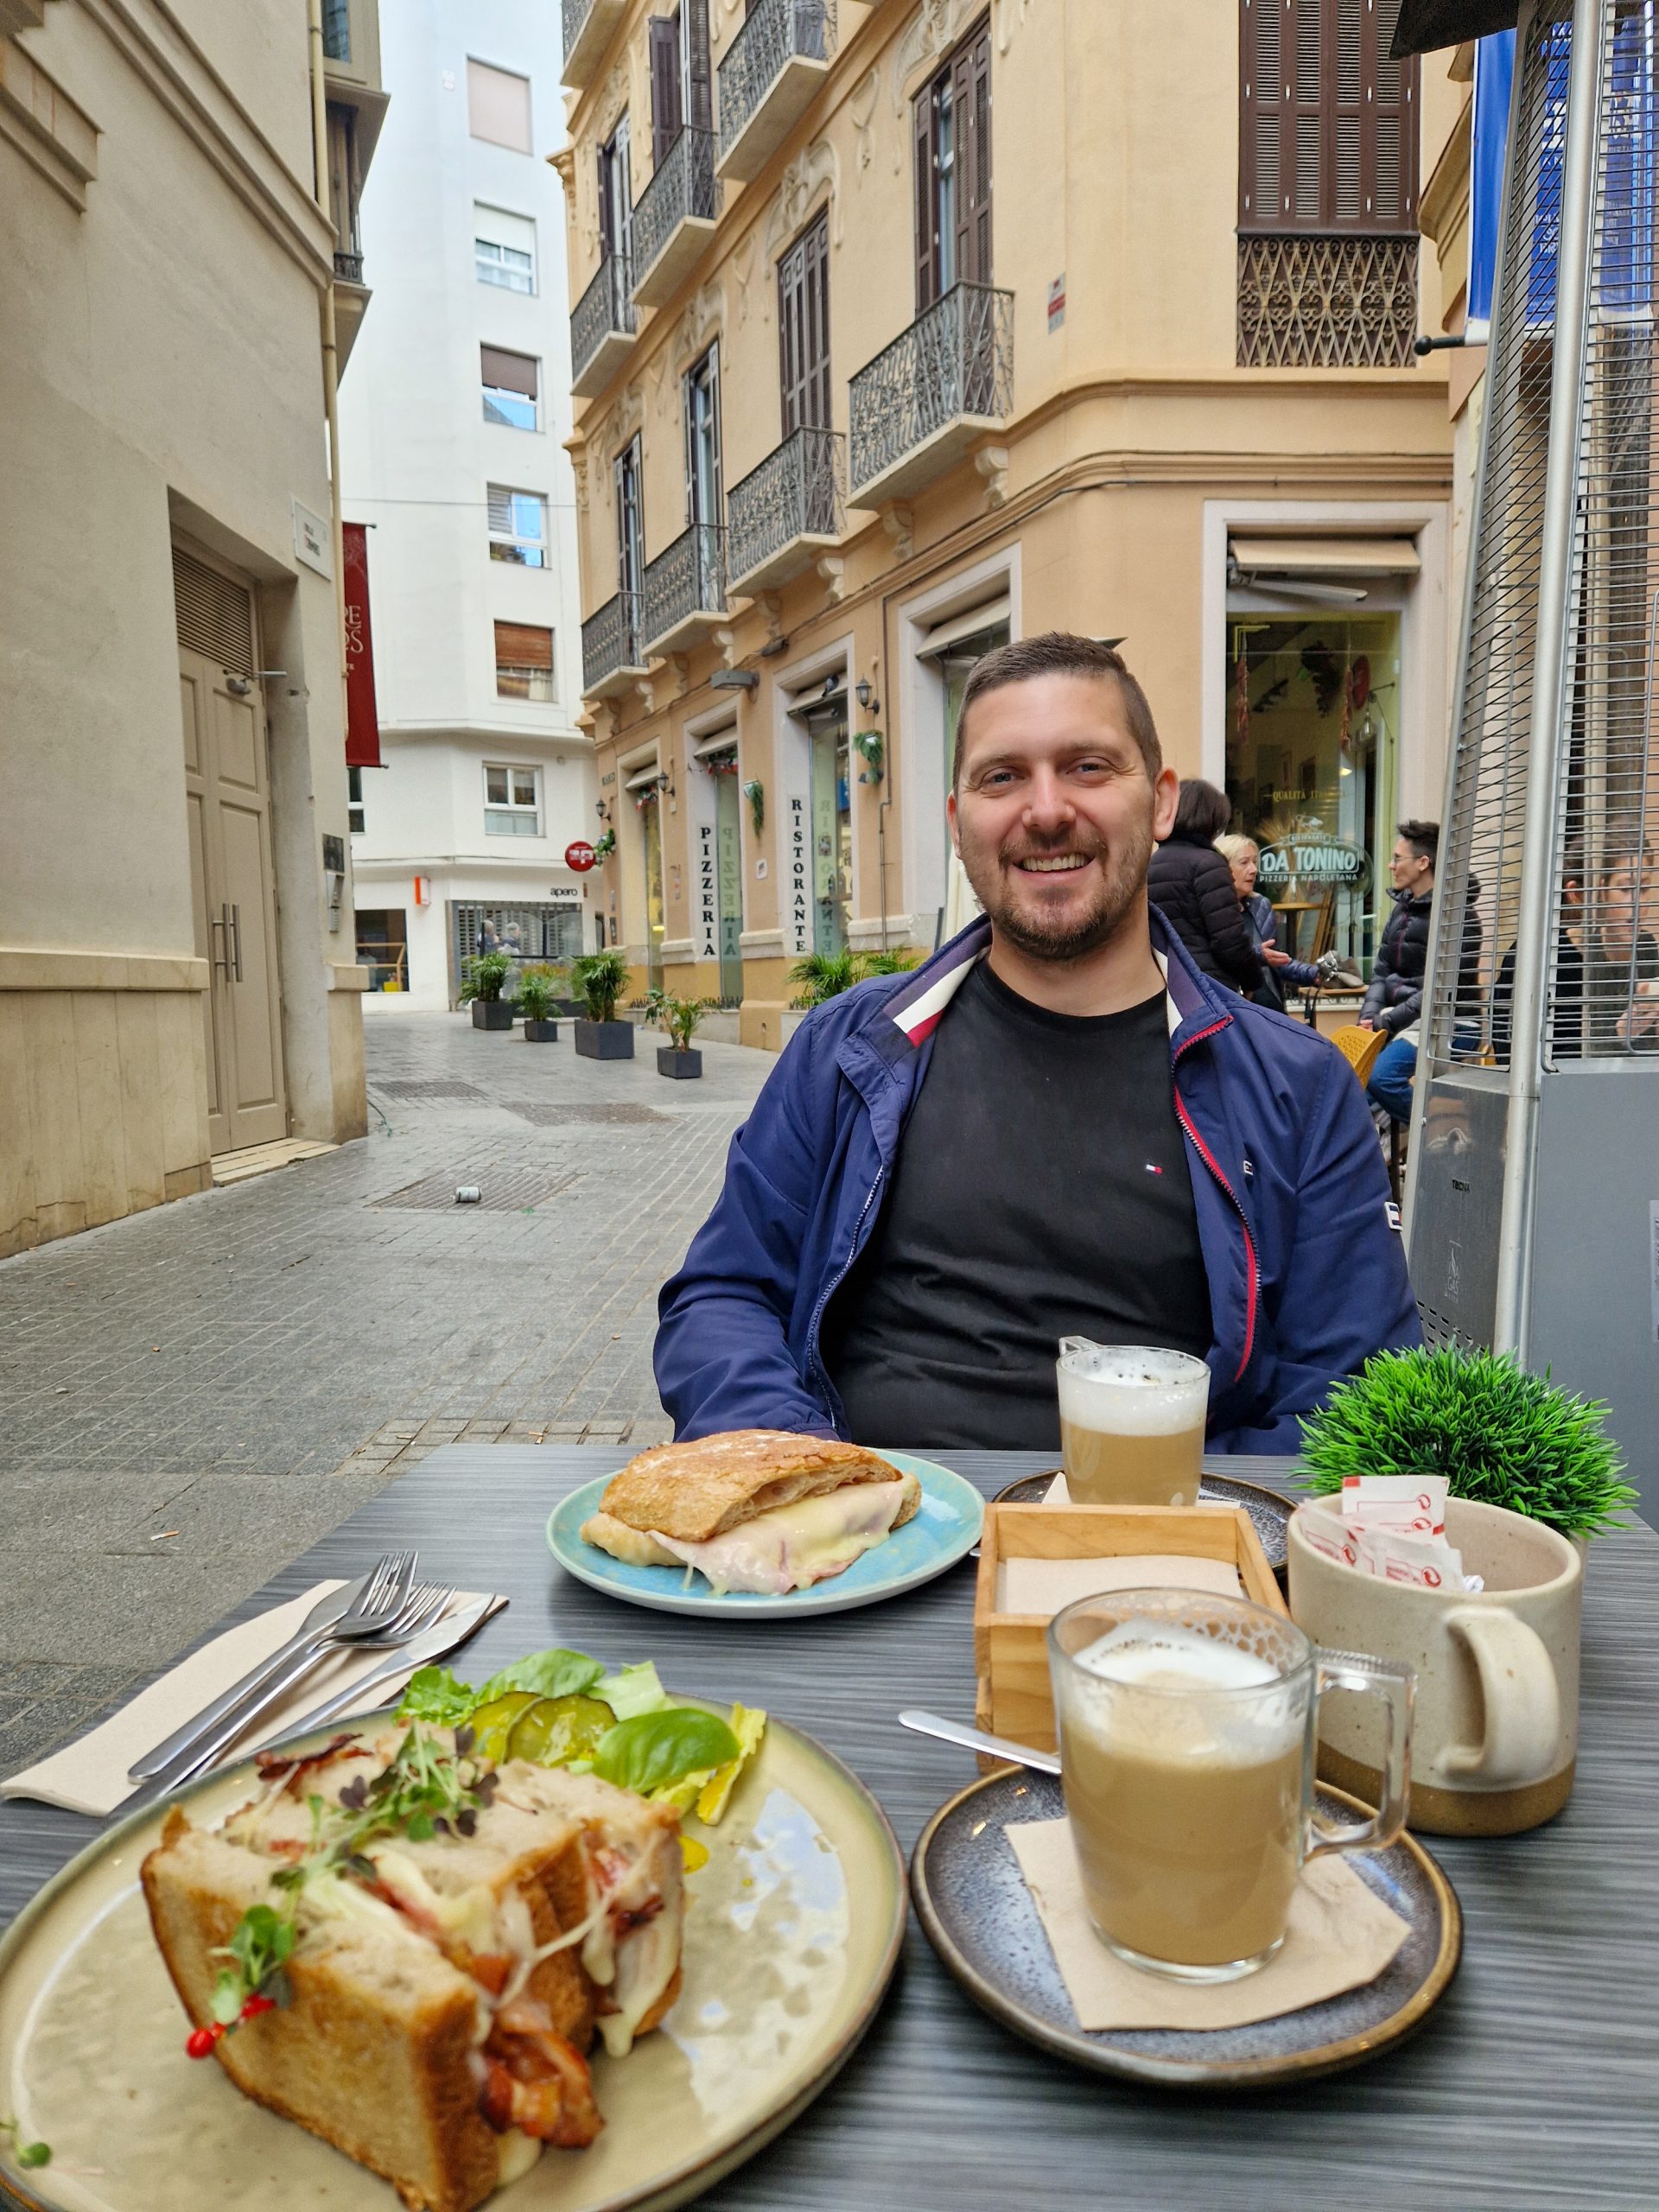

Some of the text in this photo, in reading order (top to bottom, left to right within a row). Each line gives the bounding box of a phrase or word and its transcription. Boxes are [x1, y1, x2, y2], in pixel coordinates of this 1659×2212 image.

[550, 887, 578, 898] apero
[701, 827, 715, 956] PIZZERIA
[791, 799, 806, 952] RISTORANTE
[1262, 847, 1357, 872] DA TONINO
